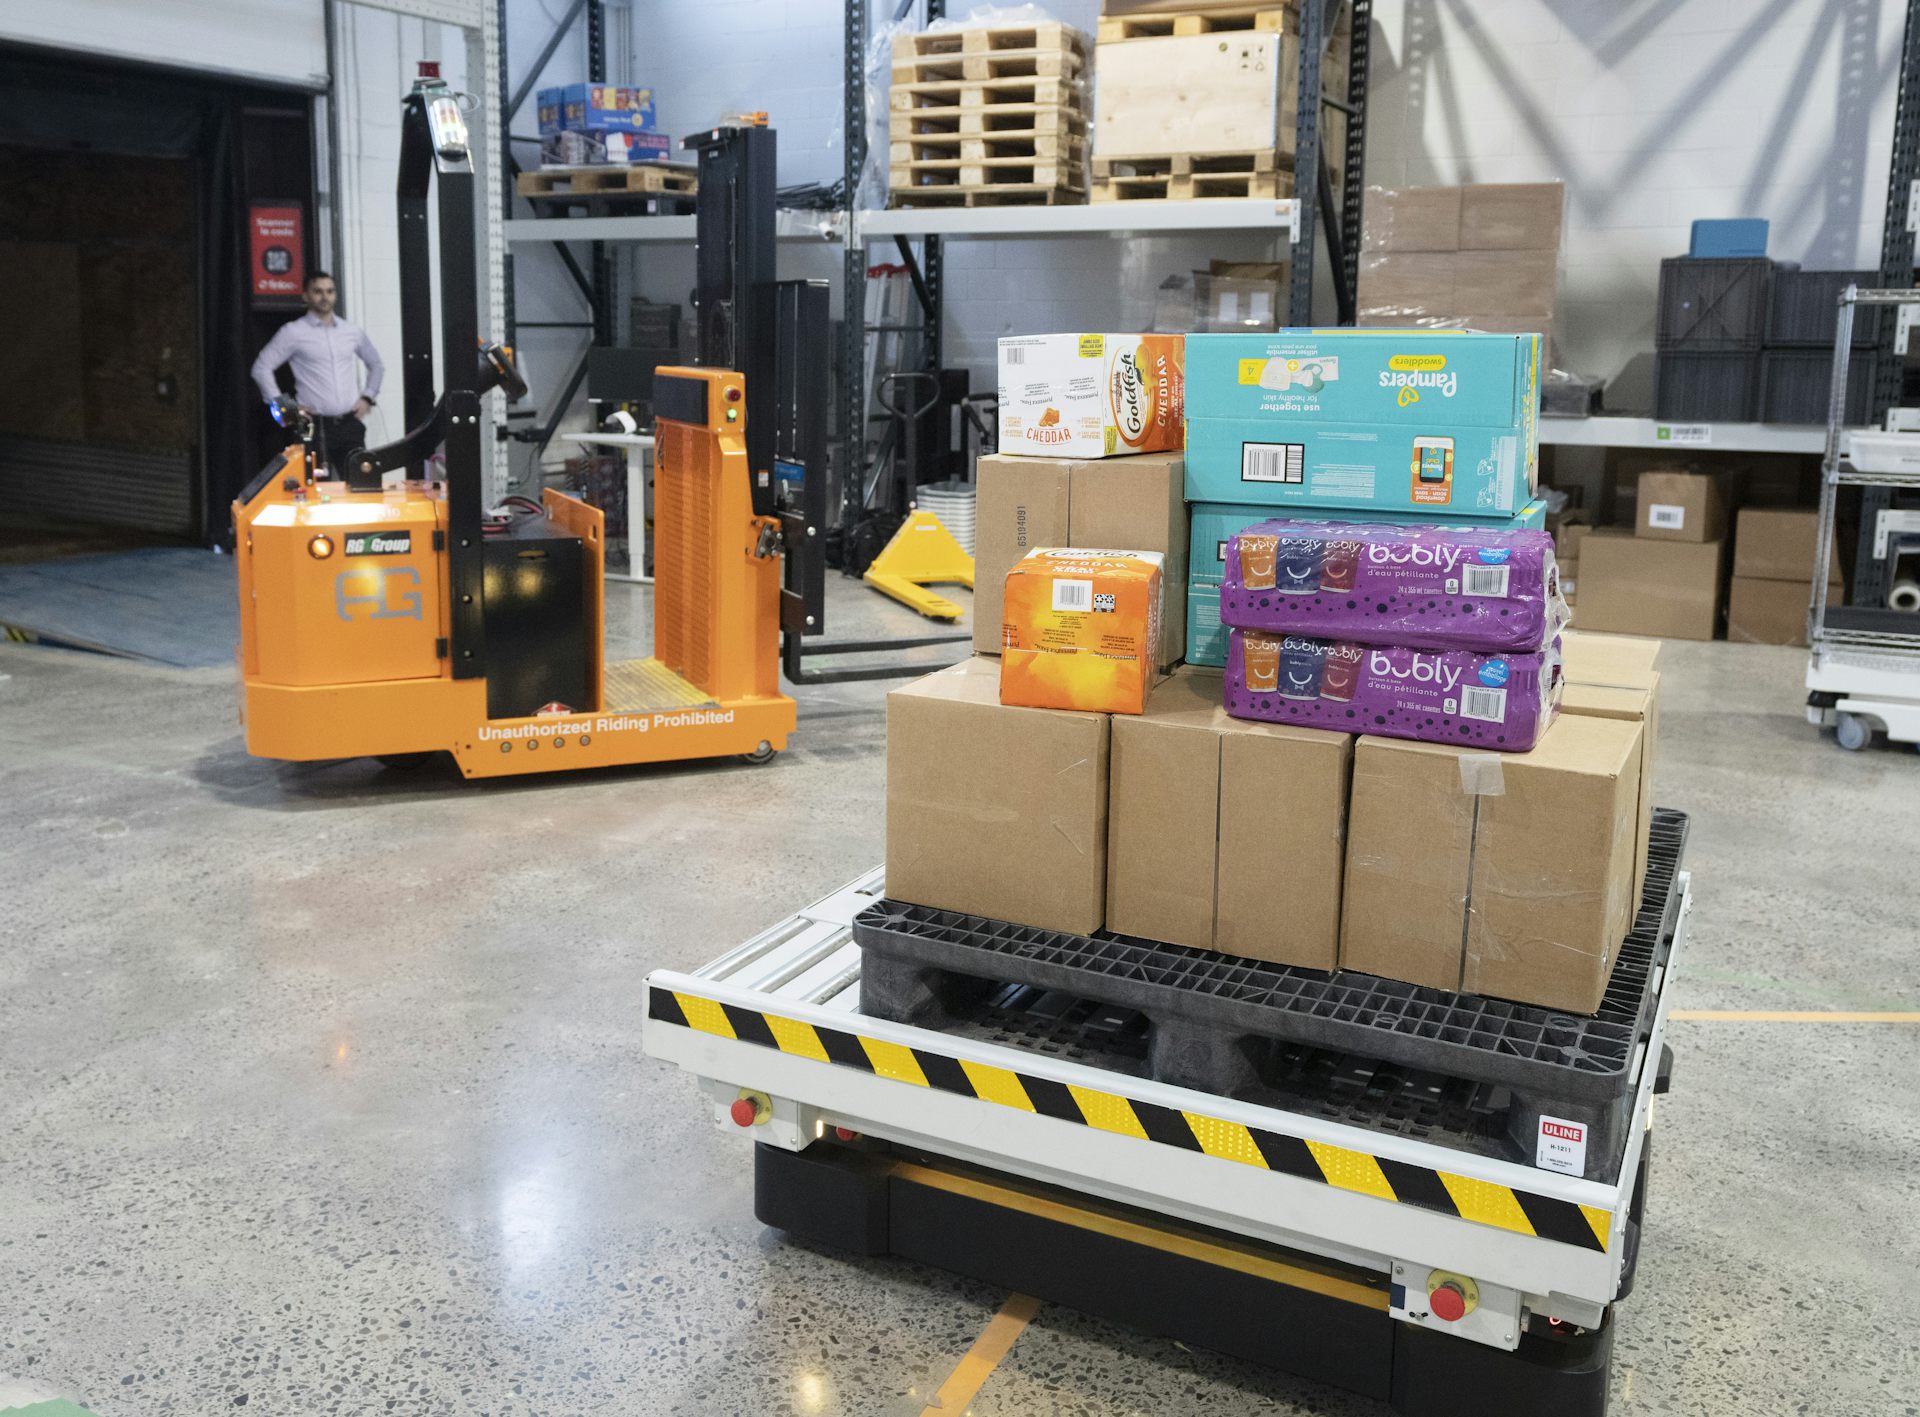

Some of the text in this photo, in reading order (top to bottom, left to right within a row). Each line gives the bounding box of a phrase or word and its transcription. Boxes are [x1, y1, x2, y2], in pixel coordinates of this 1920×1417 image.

[1395, 358, 1442, 367] swaddlers
[1156, 354, 1169, 427] CHEDDAR
[1378, 369, 1457, 398] Pampers
[1119, 353, 1142, 434] Goldfish
[1263, 394, 1277, 402] skin
[1278, 393, 1305, 403] healthy
[1259, 402, 1320, 412] use together
[1026, 427, 1072, 444] CHEDDAR
[1415, 495, 1446, 503] download
[345, 538, 410, 554] RG Group
[1368, 543, 1462, 573] bubly
[1367, 569, 1440, 579] d'eau pétillante
[1370, 650, 1462, 693] bubly
[1367, 681, 1439, 697] d'eau pétillante
[478, 710, 734, 741] Unauthorized Riding Prohibited
[1544, 1123, 1580, 1141] ULINE
